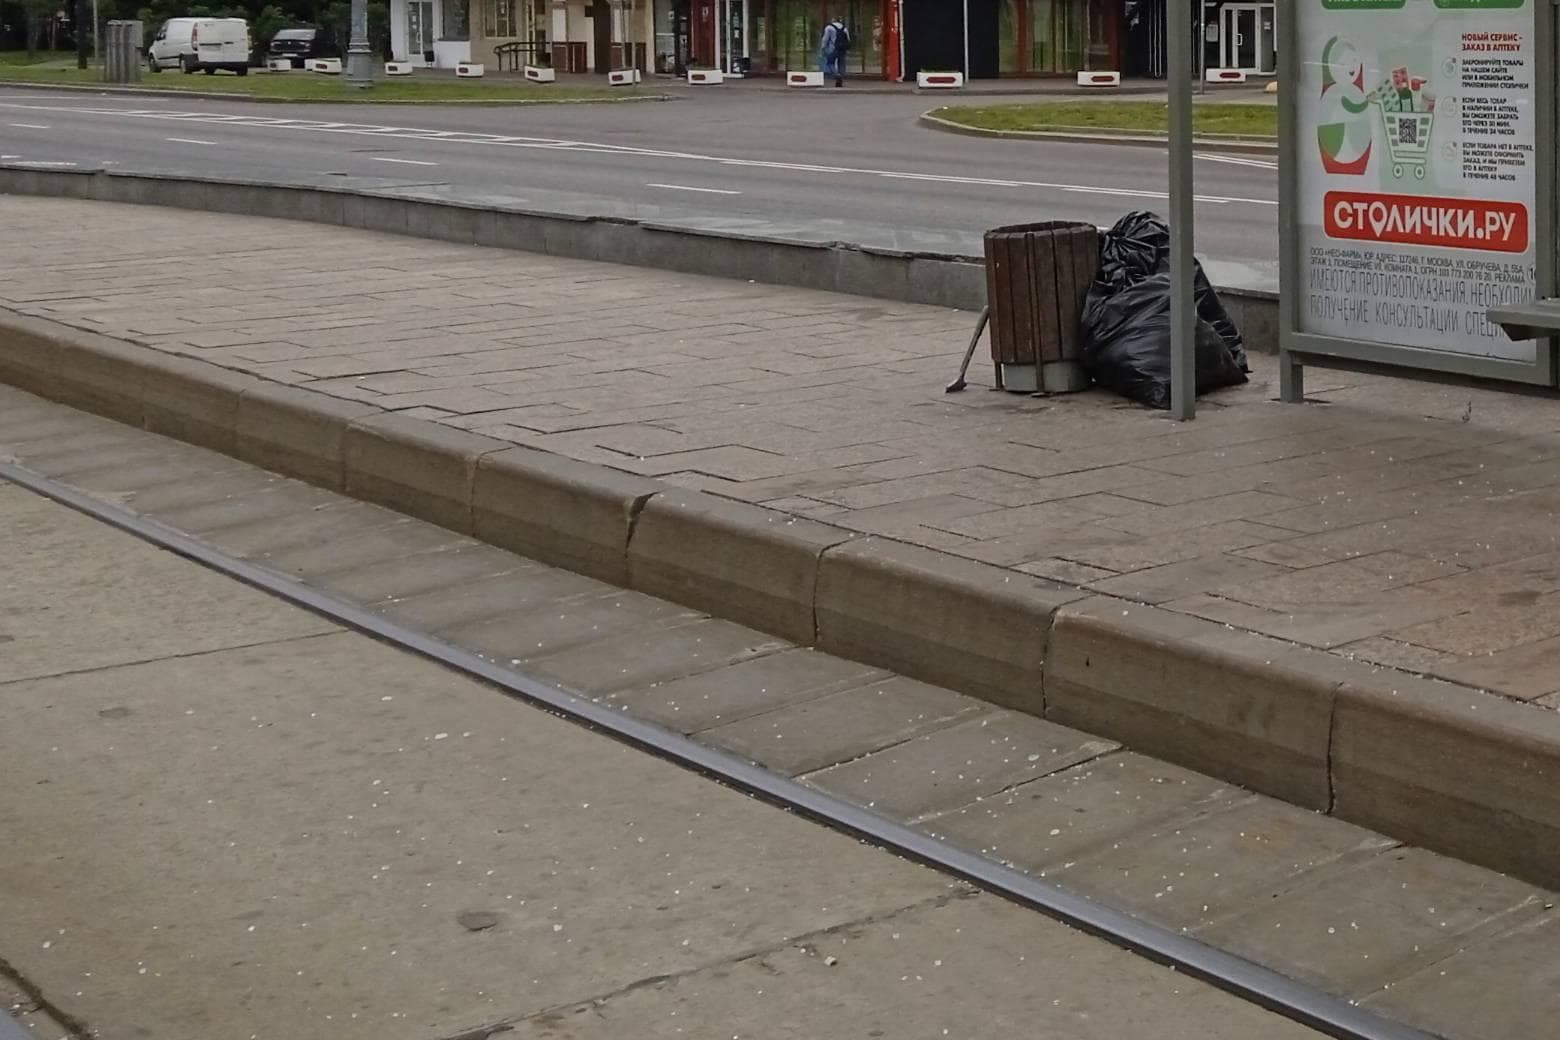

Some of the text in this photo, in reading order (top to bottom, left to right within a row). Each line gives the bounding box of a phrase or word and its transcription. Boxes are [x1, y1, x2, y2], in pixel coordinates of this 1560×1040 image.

[1462, 31, 1489, 42] НОВЫЙ
[1490, 33, 1518, 42] СЕРВИС
[1462, 43, 1485, 52] ЗАКАЗ
[1492, 43, 1521, 52] АПТЕКУ
[1333, 200, 1516, 242] СТОЛИЧКИ.РУ
[1311, 268, 1357, 294] ИМЕЮТСЯ
[1360, 271, 1469, 305] ПРОТИВОПОКАЗАНИЯ.
[1311, 294, 1458, 334] ПОЛУЧЕНИЕ КОНСУЛЬТАЦИИ
